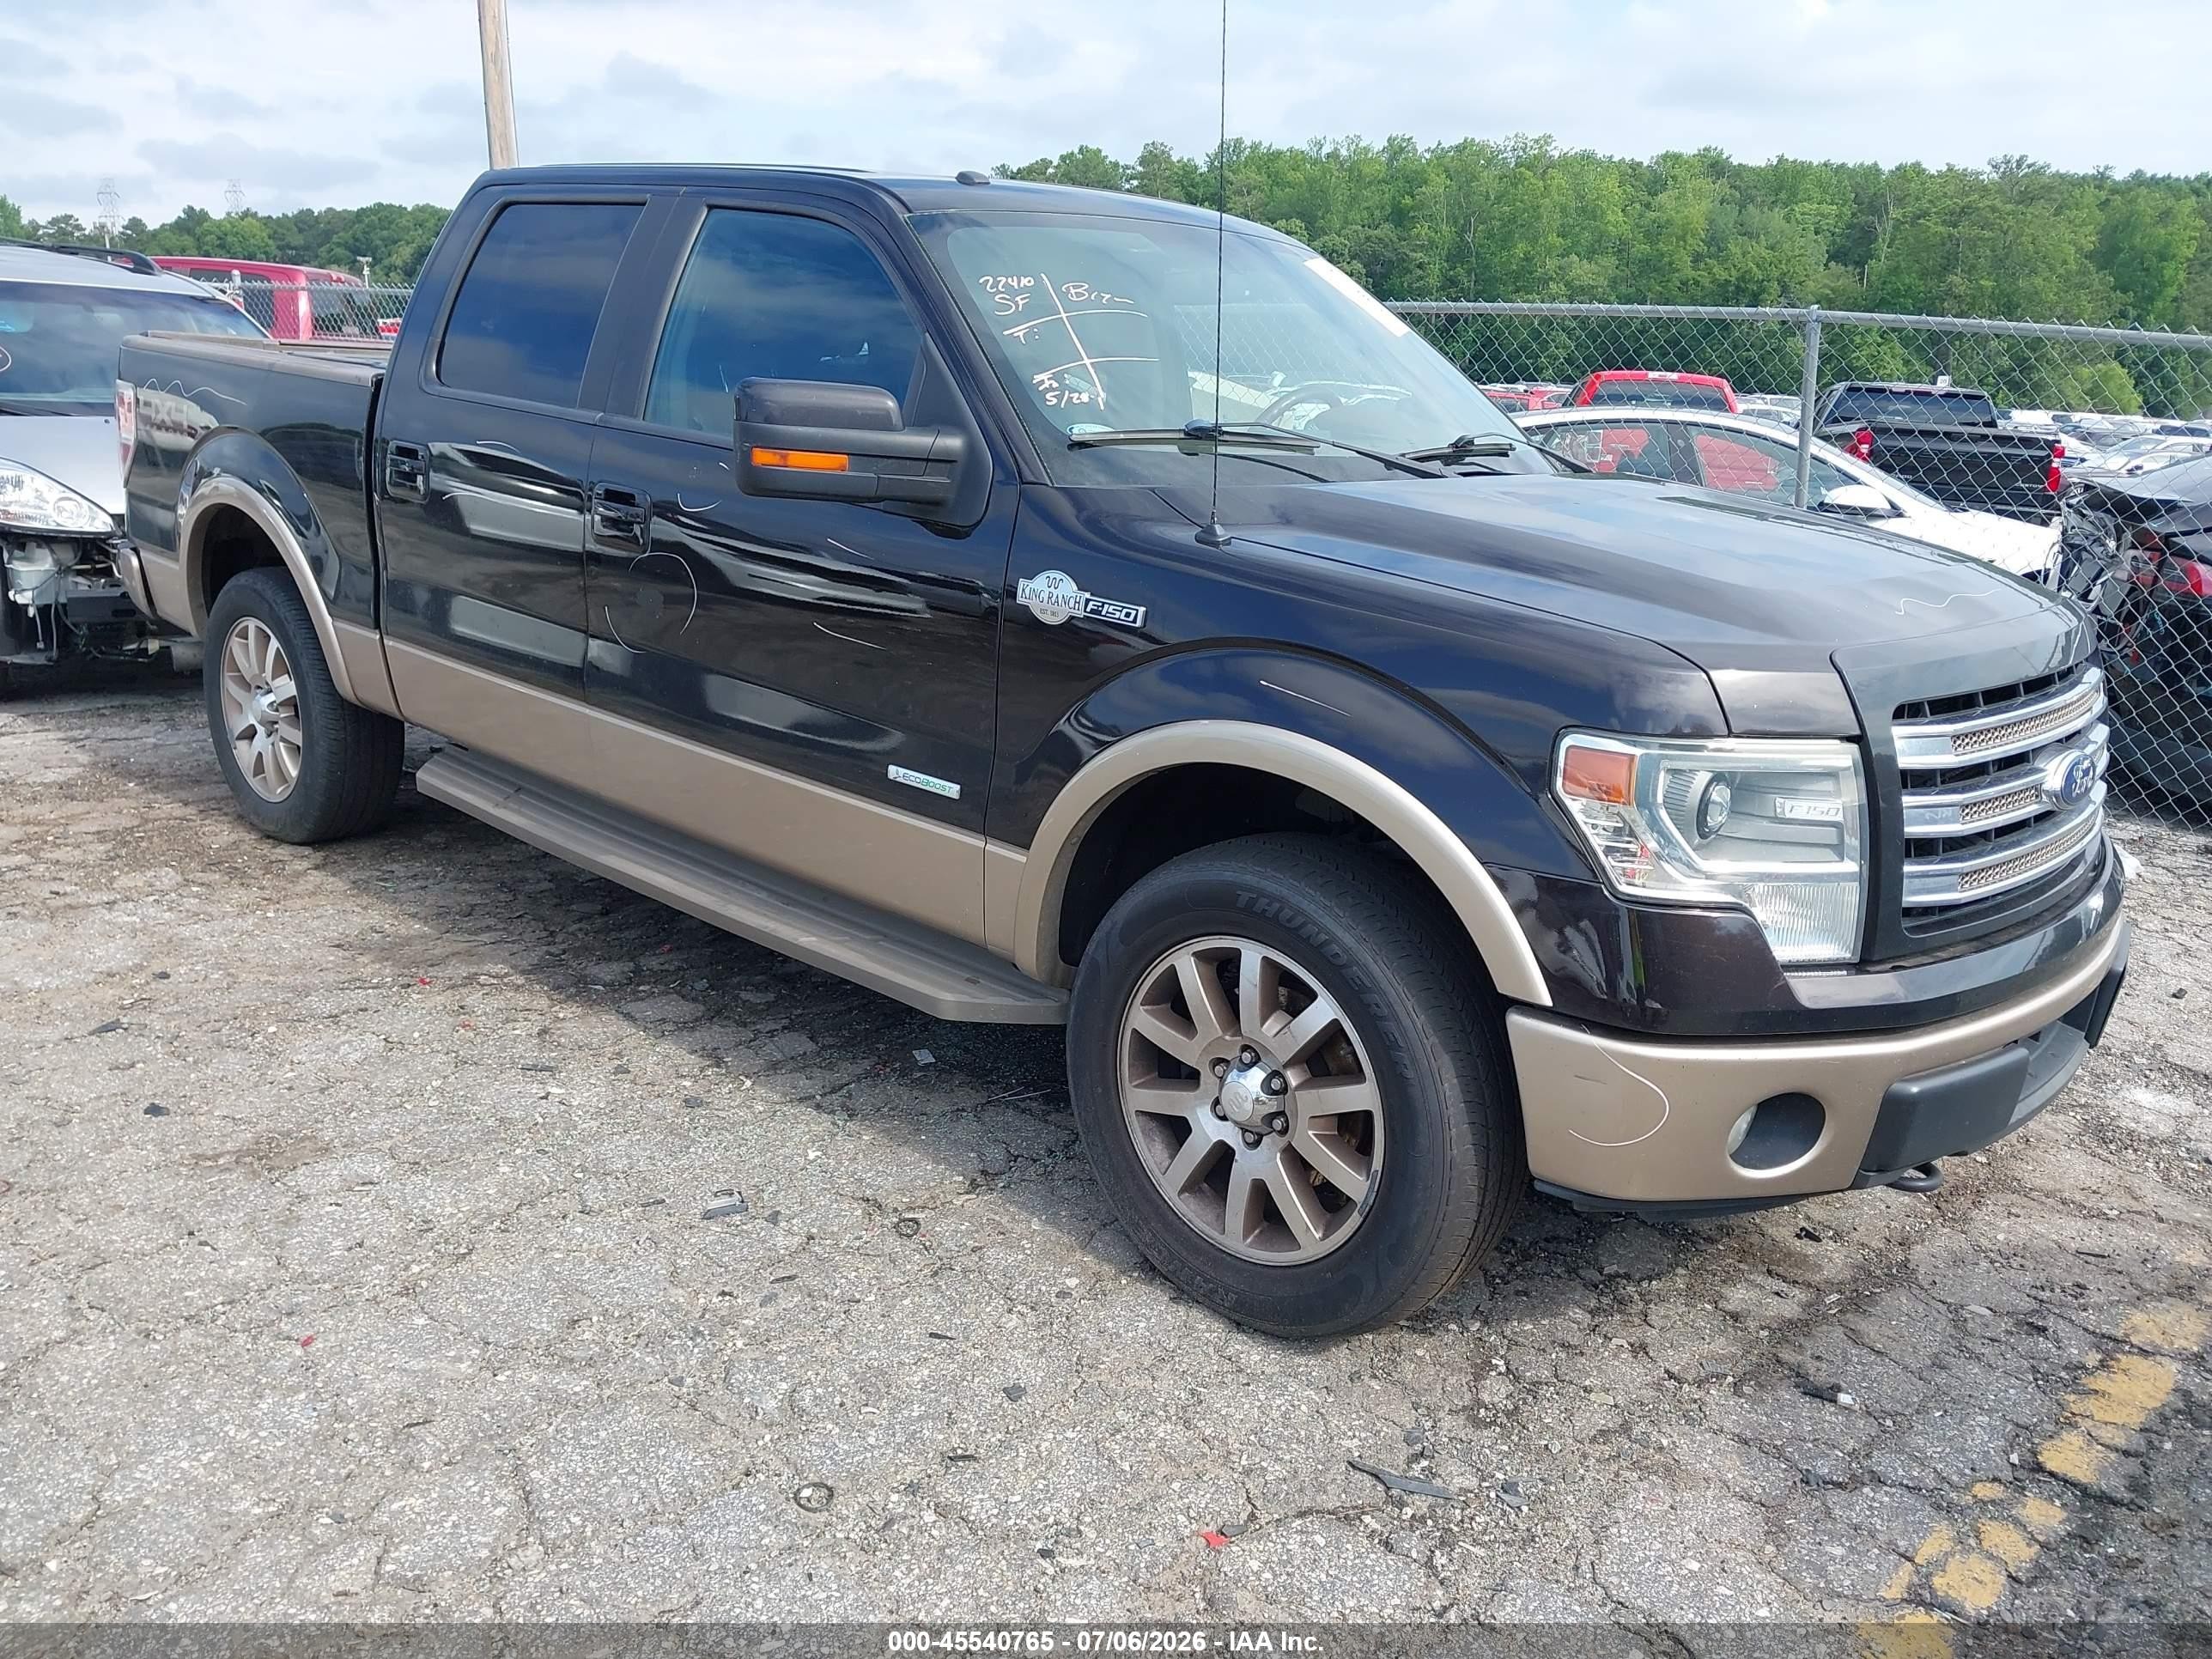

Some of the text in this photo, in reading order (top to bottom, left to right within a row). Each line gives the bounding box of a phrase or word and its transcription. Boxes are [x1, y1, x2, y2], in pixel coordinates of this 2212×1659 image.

[994, 293, 1031, 316] SF
[1020, 583, 1084, 611] KING RANCH
[1085, 601, 1137, 623] F-150
[902, 772, 954, 793] ECOBOOST
[1789, 804, 1841, 817] F150
